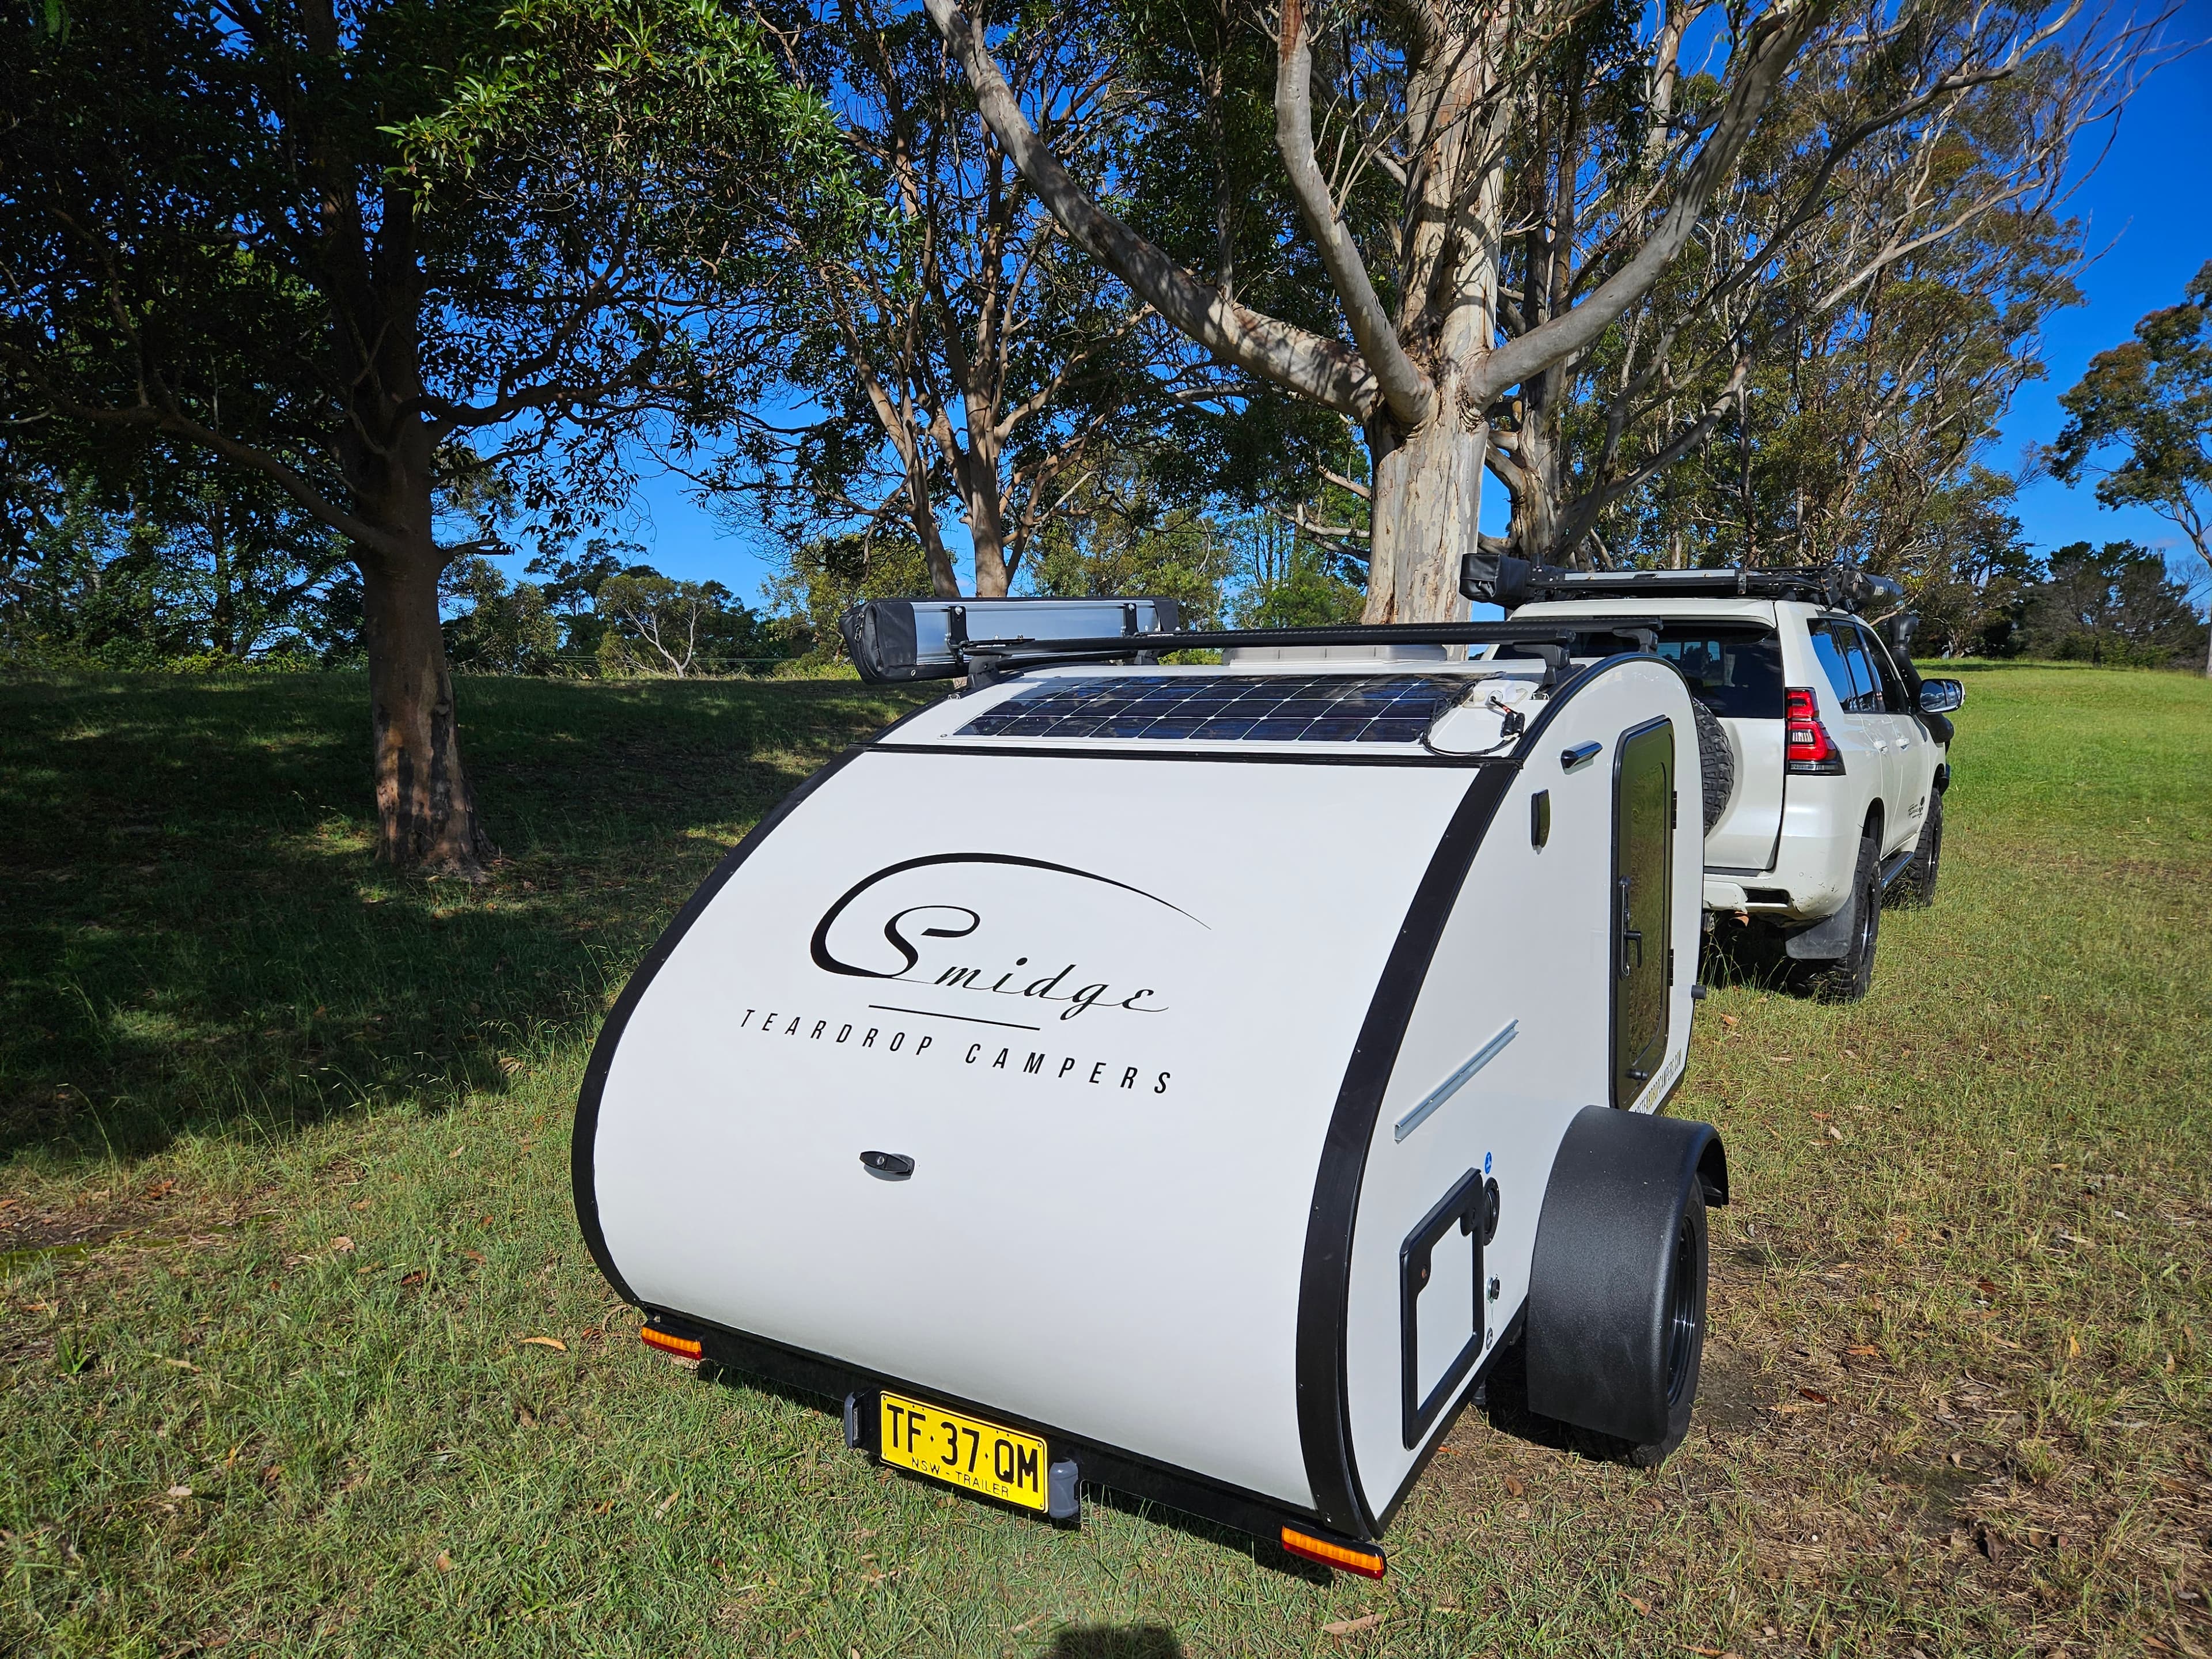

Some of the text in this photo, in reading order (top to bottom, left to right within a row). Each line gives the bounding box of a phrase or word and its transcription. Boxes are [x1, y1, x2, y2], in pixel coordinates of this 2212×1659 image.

[810, 906, 1169, 1021] Smidge
[741, 1009, 1171, 1094] TEARDROP CAMPERS
[887, 1403, 1039, 1493] TF 37 QM
[912, 1456, 940, 1475] NSW
[956, 1471, 1009, 1498] TRAILER
